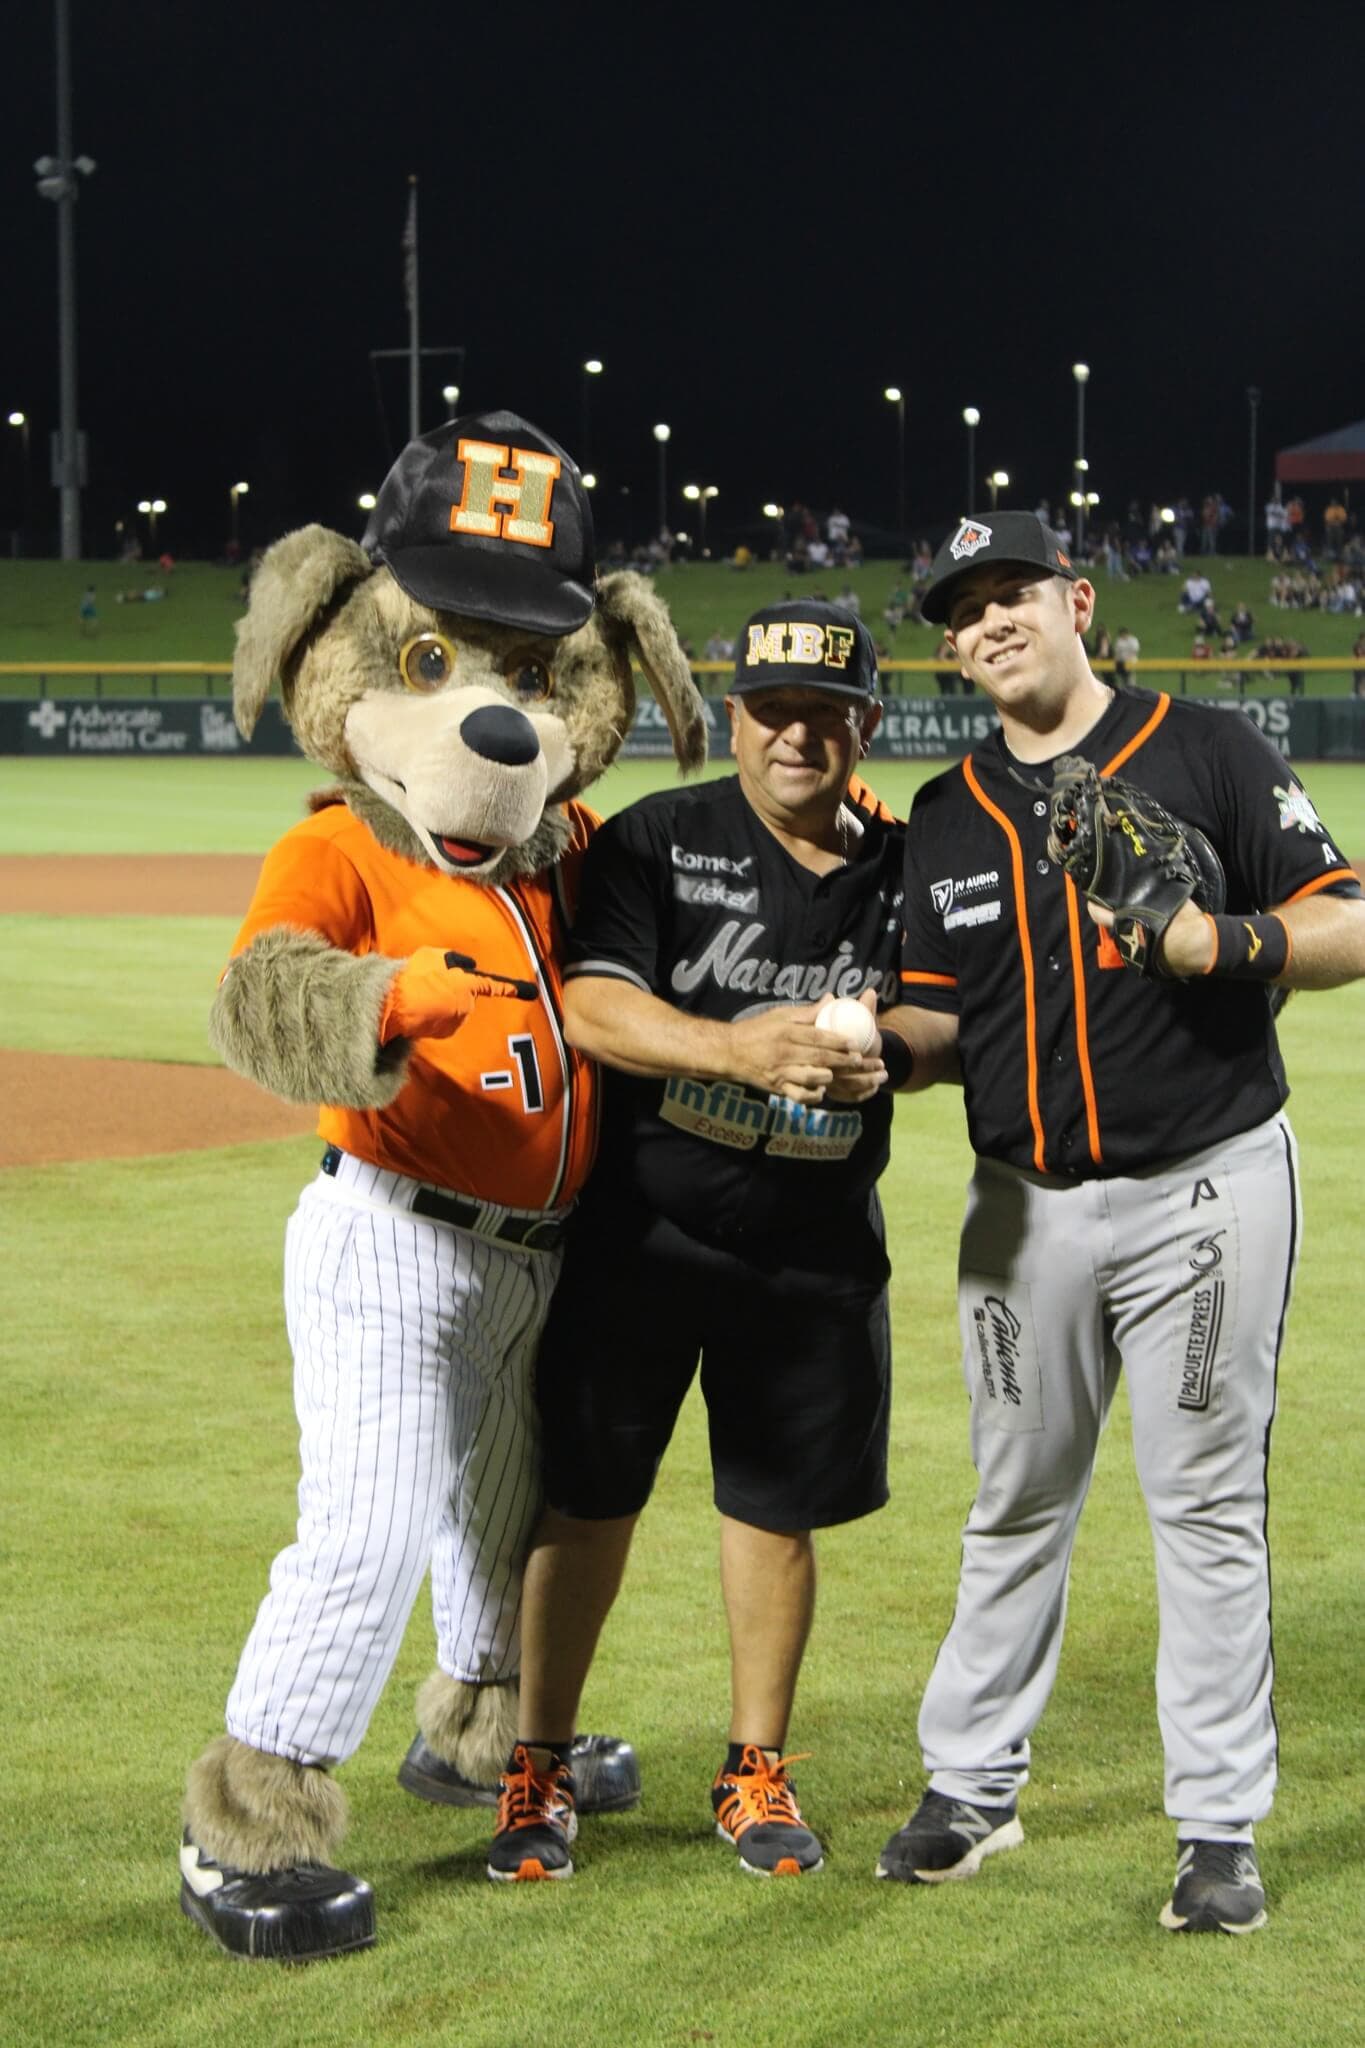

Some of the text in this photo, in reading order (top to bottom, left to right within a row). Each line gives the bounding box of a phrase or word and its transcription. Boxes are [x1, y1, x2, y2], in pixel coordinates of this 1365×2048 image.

[449, 438, 561, 547] H
[746, 622, 854, 669] MBF
[69, 706, 162, 728] Advocate
[69, 728, 187, 750] Health Care
[671, 844, 753, 877] Comex
[954, 880, 965, 893] JV
[966, 871, 999, 889] AUDIO
[1182, 1290, 1212, 1397] PAQUETEXPRESS
